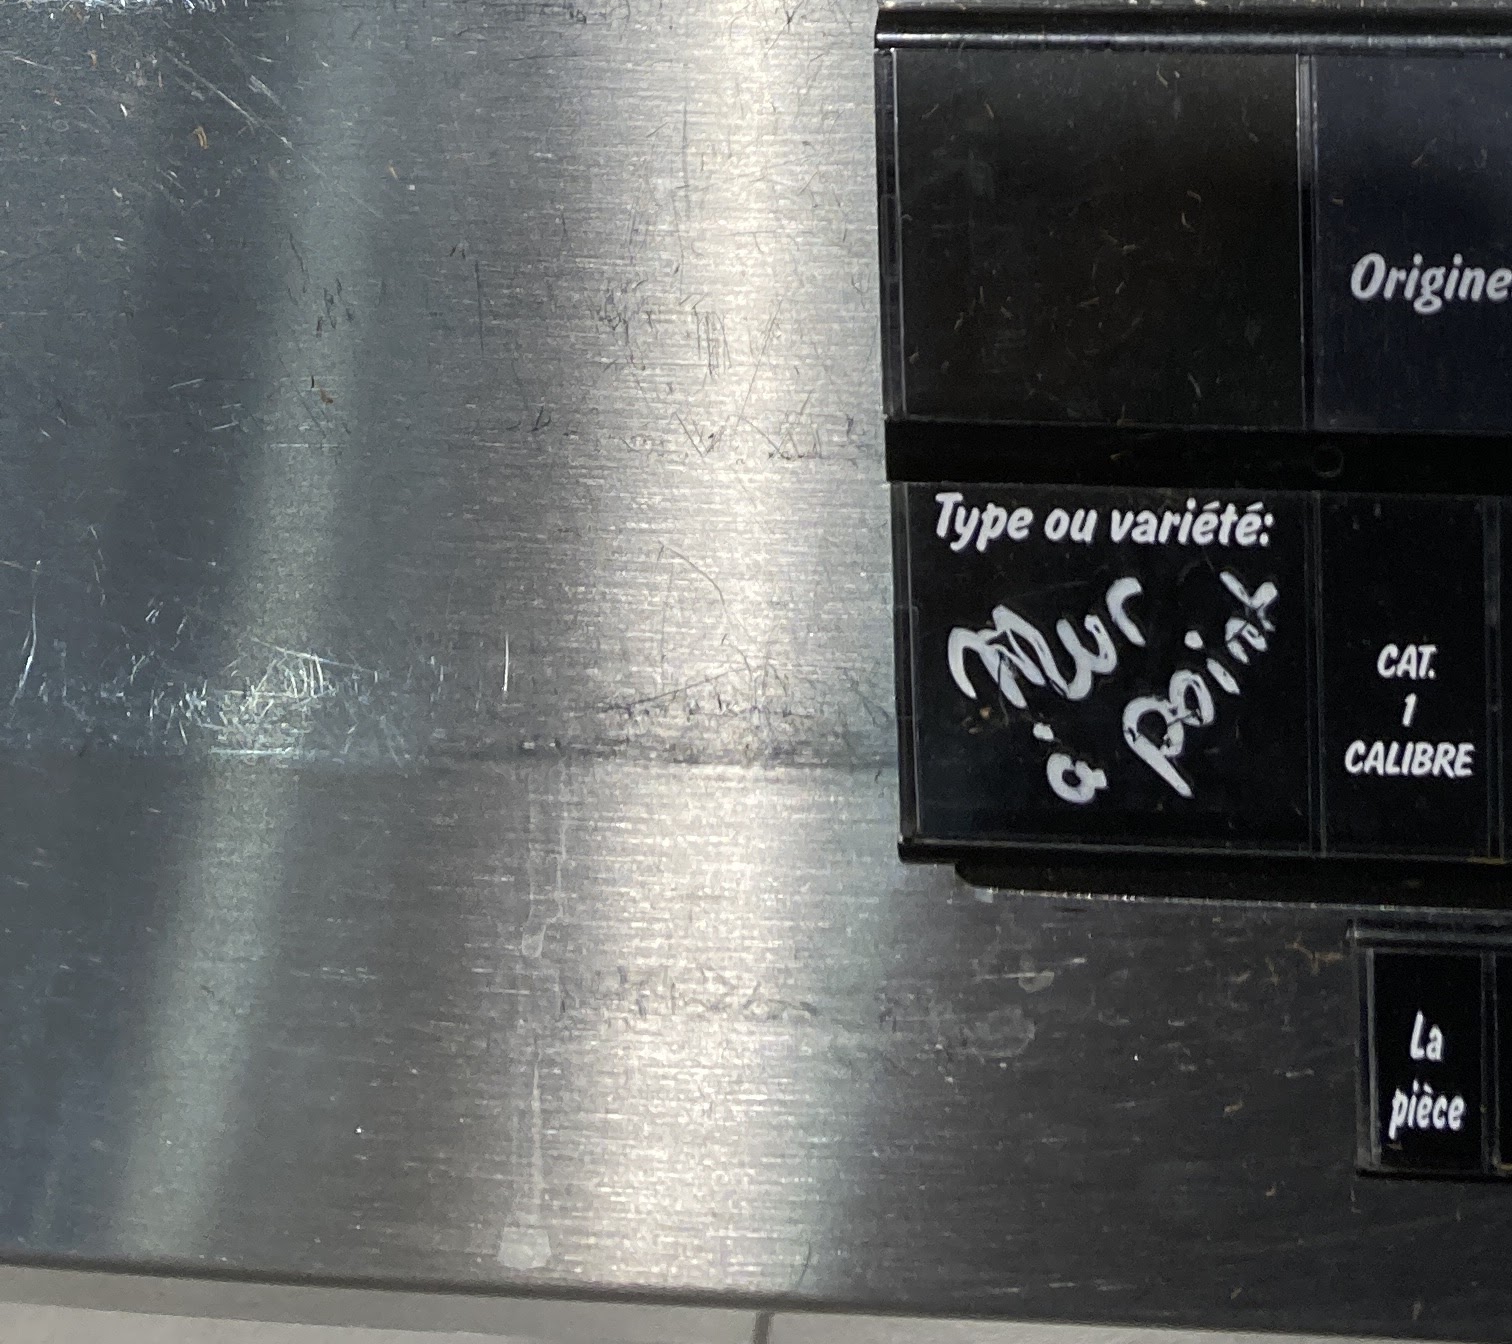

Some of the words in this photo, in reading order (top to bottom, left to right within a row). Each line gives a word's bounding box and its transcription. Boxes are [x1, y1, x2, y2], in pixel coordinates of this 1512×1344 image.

[935, 491, 1034, 553] Type
[1044, 506, 1098, 543] ou
[1110, 497, 1275, 547] variété:
[1122, 570, 1279, 799] point
[1377, 644, 1437, 680] CAT.
[1401, 694, 1417, 727] 1
[1344, 740, 1476, 779] CALIBRE
[1409, 1010, 1443, 1062] La
[1388, 1082, 1465, 1140] pièce
